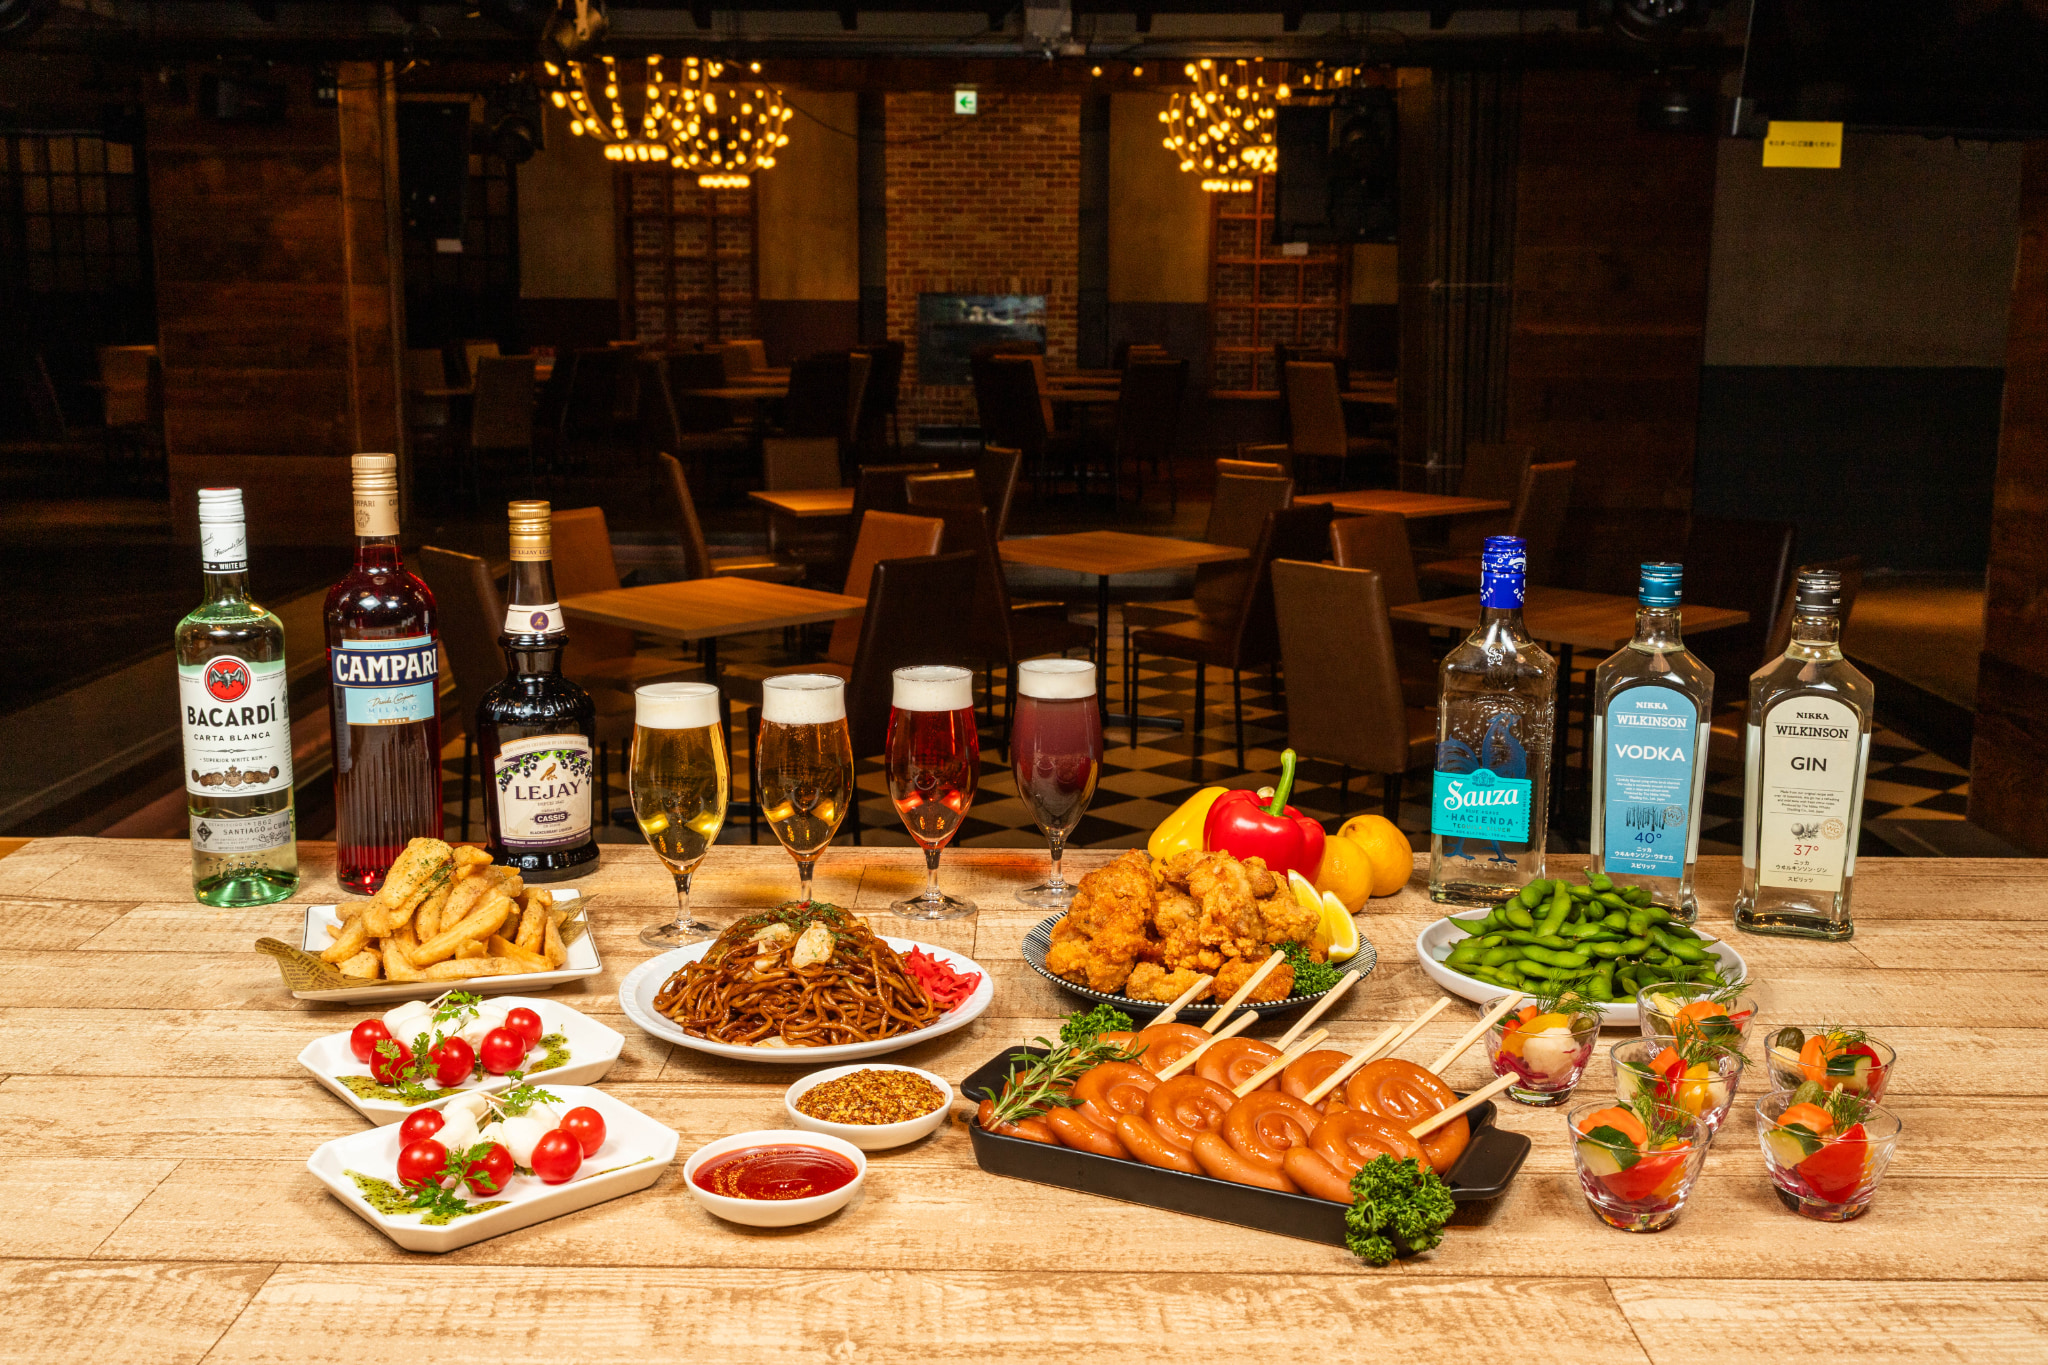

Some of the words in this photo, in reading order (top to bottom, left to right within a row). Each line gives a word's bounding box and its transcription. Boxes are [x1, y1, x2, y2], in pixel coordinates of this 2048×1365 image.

[219, 562, 239, 570] WHITE
[336, 648, 438, 682] CAMPARI
[187, 696, 276, 727] BACARDÍ
[368, 704, 417, 713] MILANO
[1635, 702, 1668, 710] NIKKA
[1616, 714, 1687, 728] WILKINSON
[1796, 712, 1829, 720] NIKKA
[193, 733, 225, 741] CARTA
[229, 731, 271, 741] BLANCA
[1776, 725, 1849, 738] WILKINSON
[1615, 744, 1686, 762] VODKA
[1790, 756, 1827, 772] GIN
[515, 779, 581, 800] LEJAY
[1443, 780, 1519, 810] Sauza
[253, 819, 272, 827] 1862
[537, 813, 565, 822] CASSIS
[1451, 813, 1514, 826] HACIENDA
[223, 826, 265, 836] SANTIAGO
[273, 820, 289, 830] CUBA
[1634, 832, 1662, 844] 40°
[1793, 844, 1819, 856] 37°
[1631, 862, 1656, 870] スピリッツ
